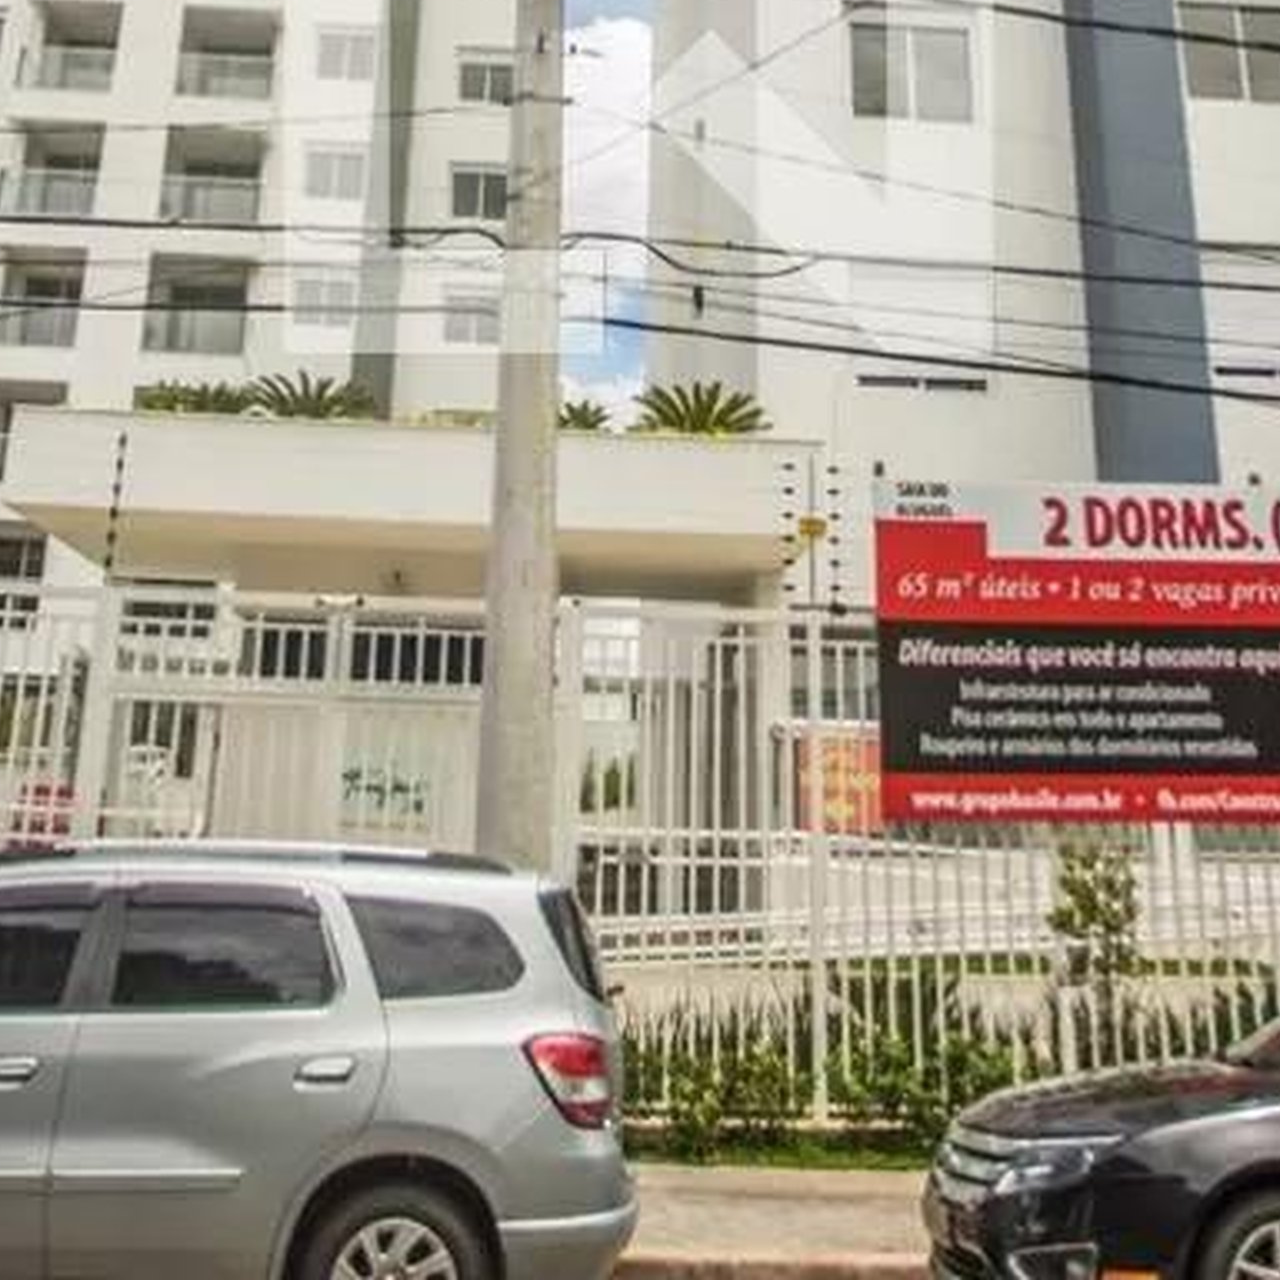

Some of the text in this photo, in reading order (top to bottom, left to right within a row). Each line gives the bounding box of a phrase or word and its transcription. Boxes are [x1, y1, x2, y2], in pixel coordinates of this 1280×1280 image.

[1042, 497, 1070, 548] 2
[1084, 497, 1264, 551] DORMS.
[897, 573, 929, 599] 65
[979, 572, 1042, 600] úteis
[1069, 577, 1081, 600] 1
[1088, 581, 1122, 601] ou
[1128, 577, 1146, 601] 2
[1151, 582, 1223, 609] vagas
[899, 638, 1021, 667] Diferenciais
[1026, 646, 1066, 673] que
[1069, 641, 1114, 668] você
[1118, 641, 1141, 668] só
[1145, 643, 1237, 668] encontra
